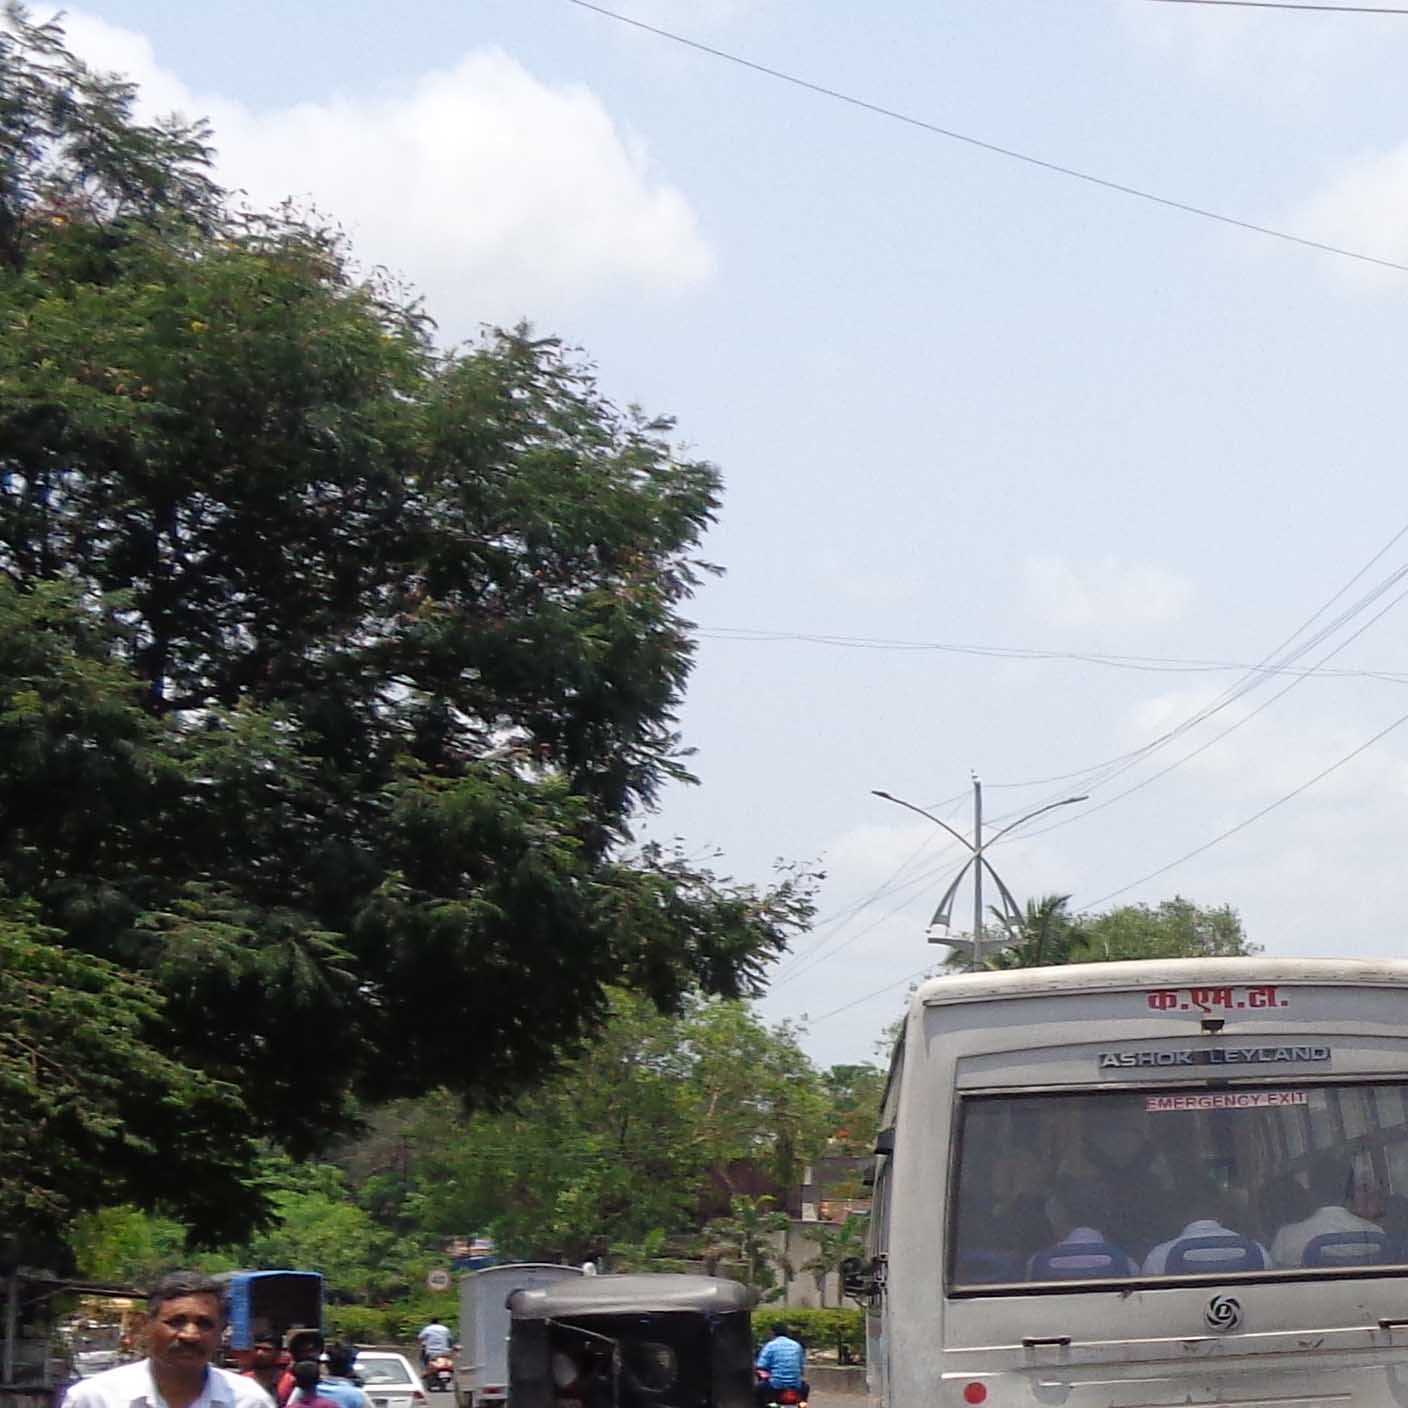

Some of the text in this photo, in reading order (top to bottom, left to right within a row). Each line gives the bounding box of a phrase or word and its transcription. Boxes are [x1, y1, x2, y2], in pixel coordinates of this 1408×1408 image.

[1102, 1046, 1330, 1067] ASHOK LEYLAND
[1149, 1091, 1306, 1110] EMERGENCY EXIT
